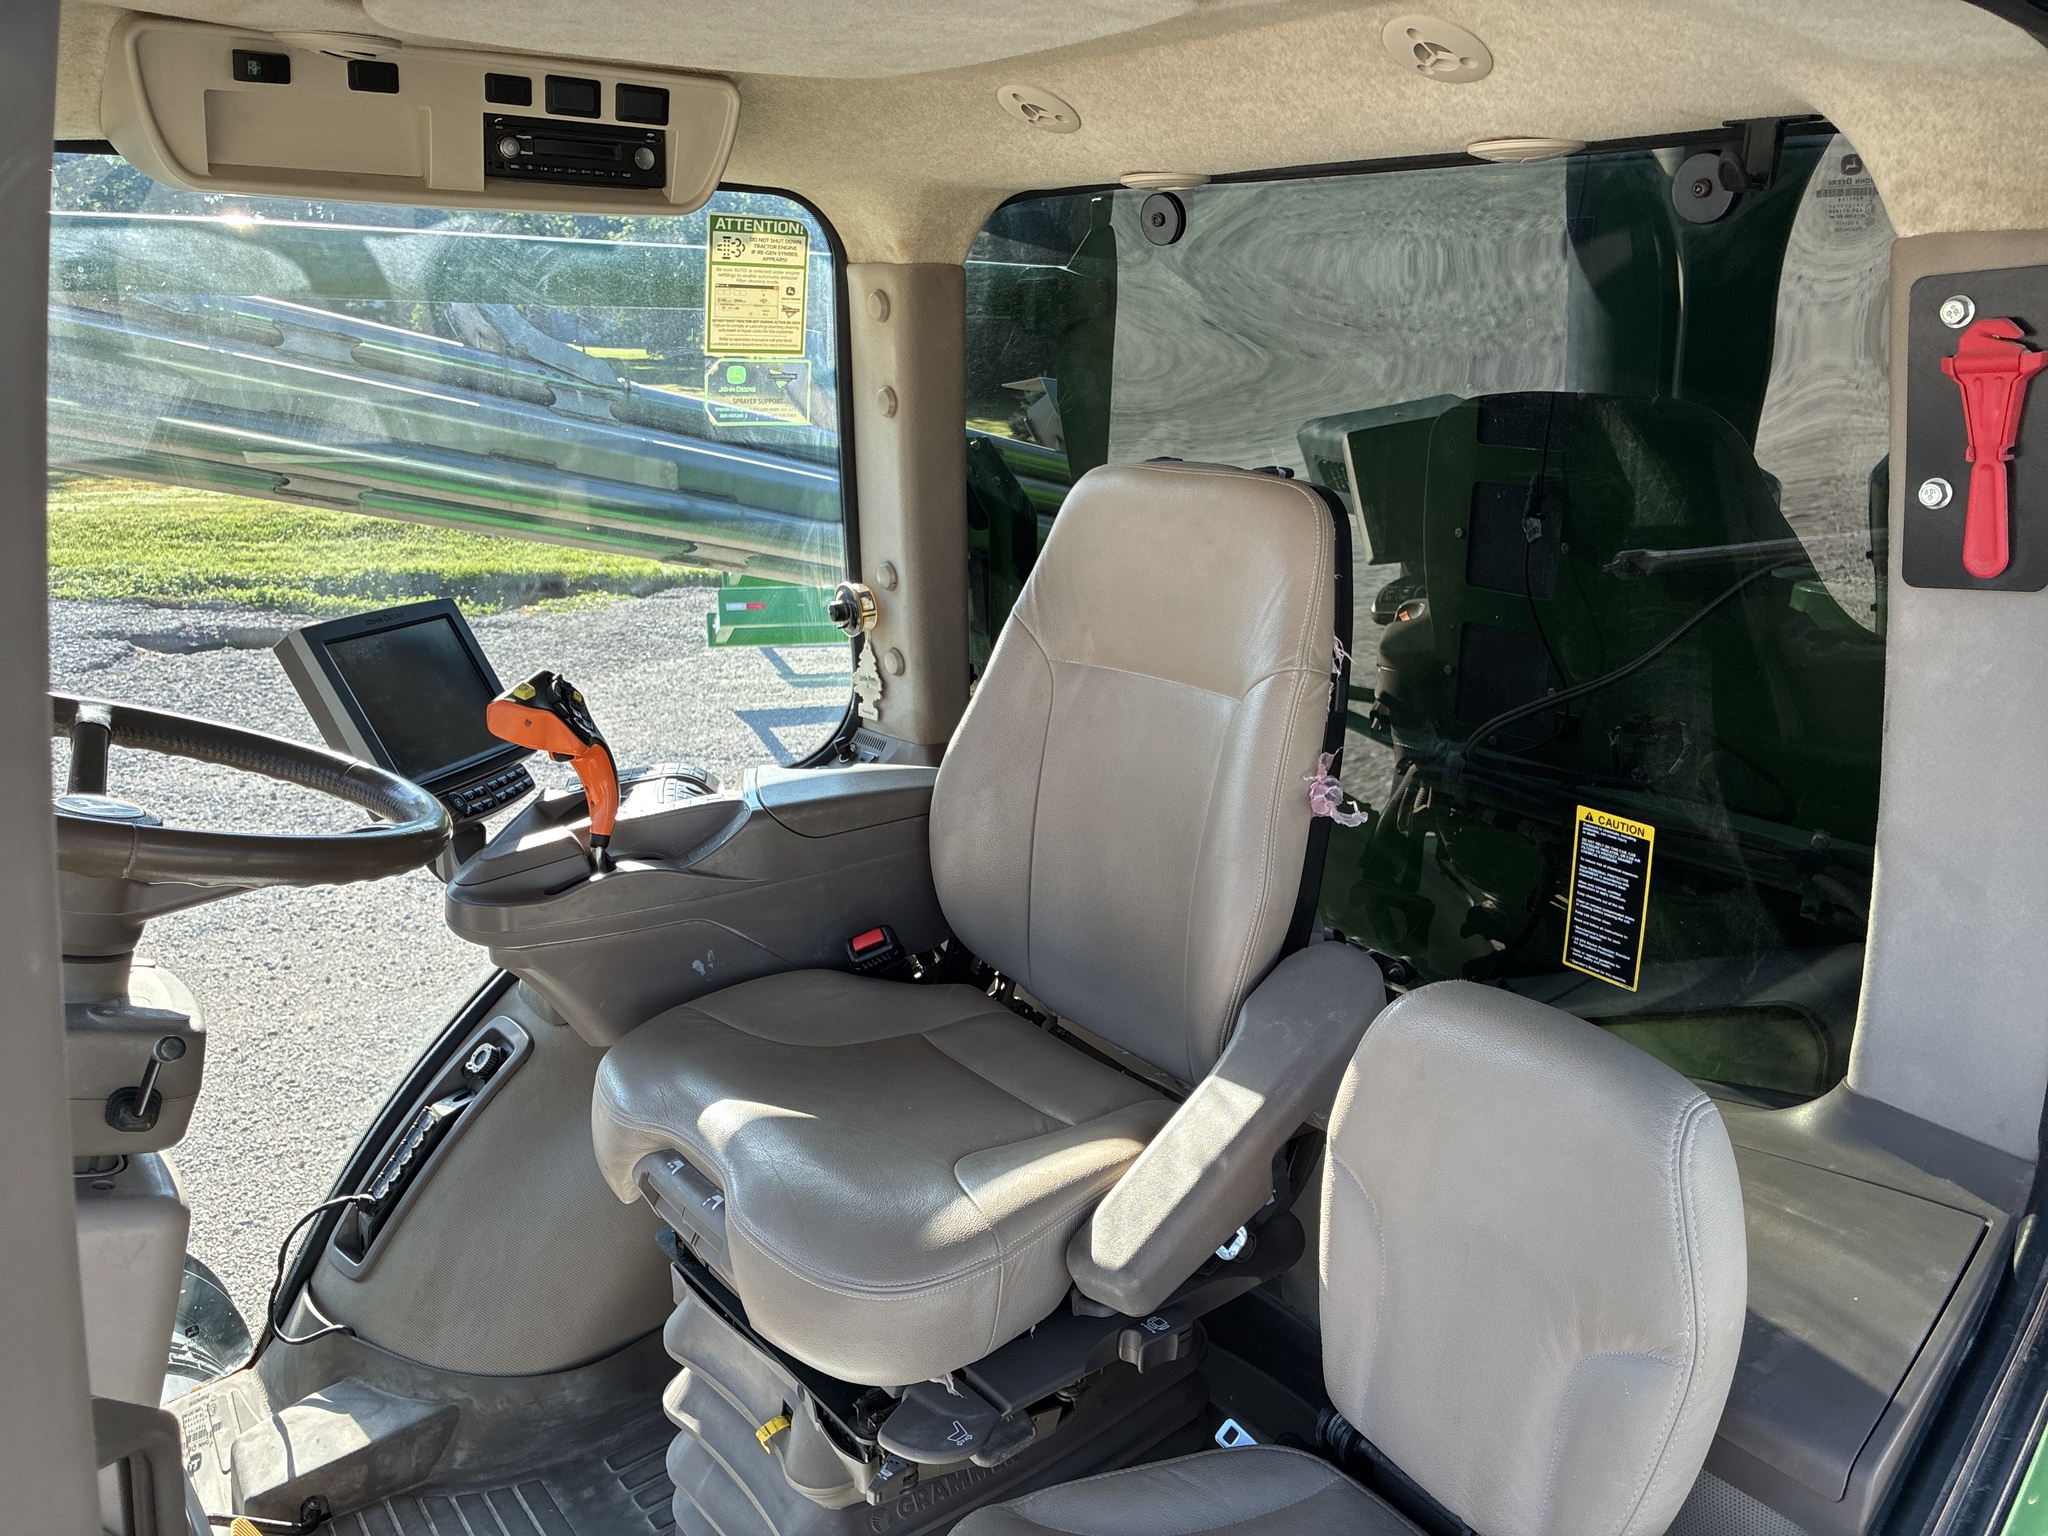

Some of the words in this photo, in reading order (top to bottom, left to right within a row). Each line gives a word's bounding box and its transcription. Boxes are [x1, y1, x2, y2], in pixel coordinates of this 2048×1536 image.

[715, 217, 804, 234] ATTENTION!
[1598, 816, 1644, 837] CAUTION
[896, 1454, 1021, 1517] GRAMM
